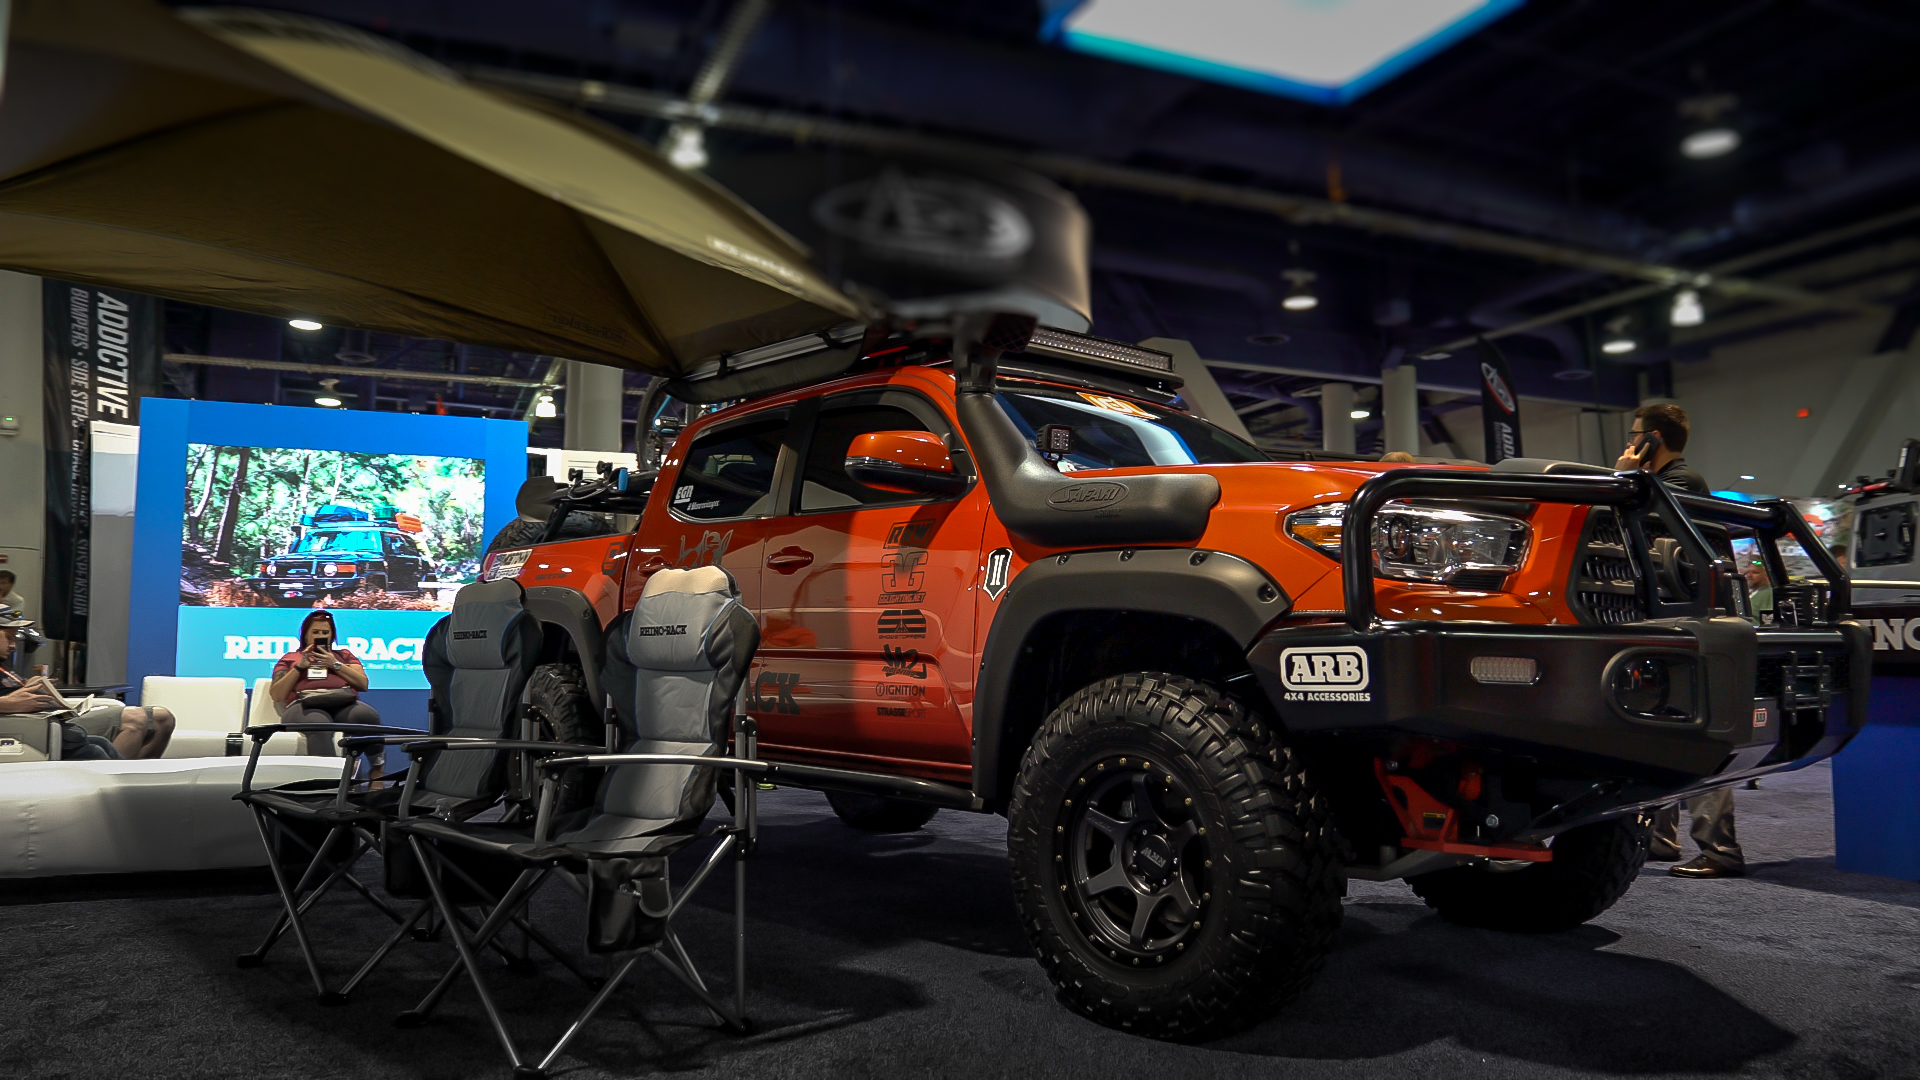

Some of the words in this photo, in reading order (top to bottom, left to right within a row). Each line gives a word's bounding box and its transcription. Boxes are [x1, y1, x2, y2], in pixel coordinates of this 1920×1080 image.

[70, 287, 90, 350] BUMPERS
[97, 291, 129, 419] ADDICTIVE
[70, 358, 90, 389] SIDE
[1049, 485, 1122, 505] SAFARI
[887, 523, 932, 545] RRW
[639, 624, 688, 637] RHINO-RACK
[1290, 655, 1362, 684] ARB
[885, 685, 926, 697] IGNITION
[1284, 692, 1305, 702] 4X4
[1307, 692, 1371, 702] ACCESSORIES
